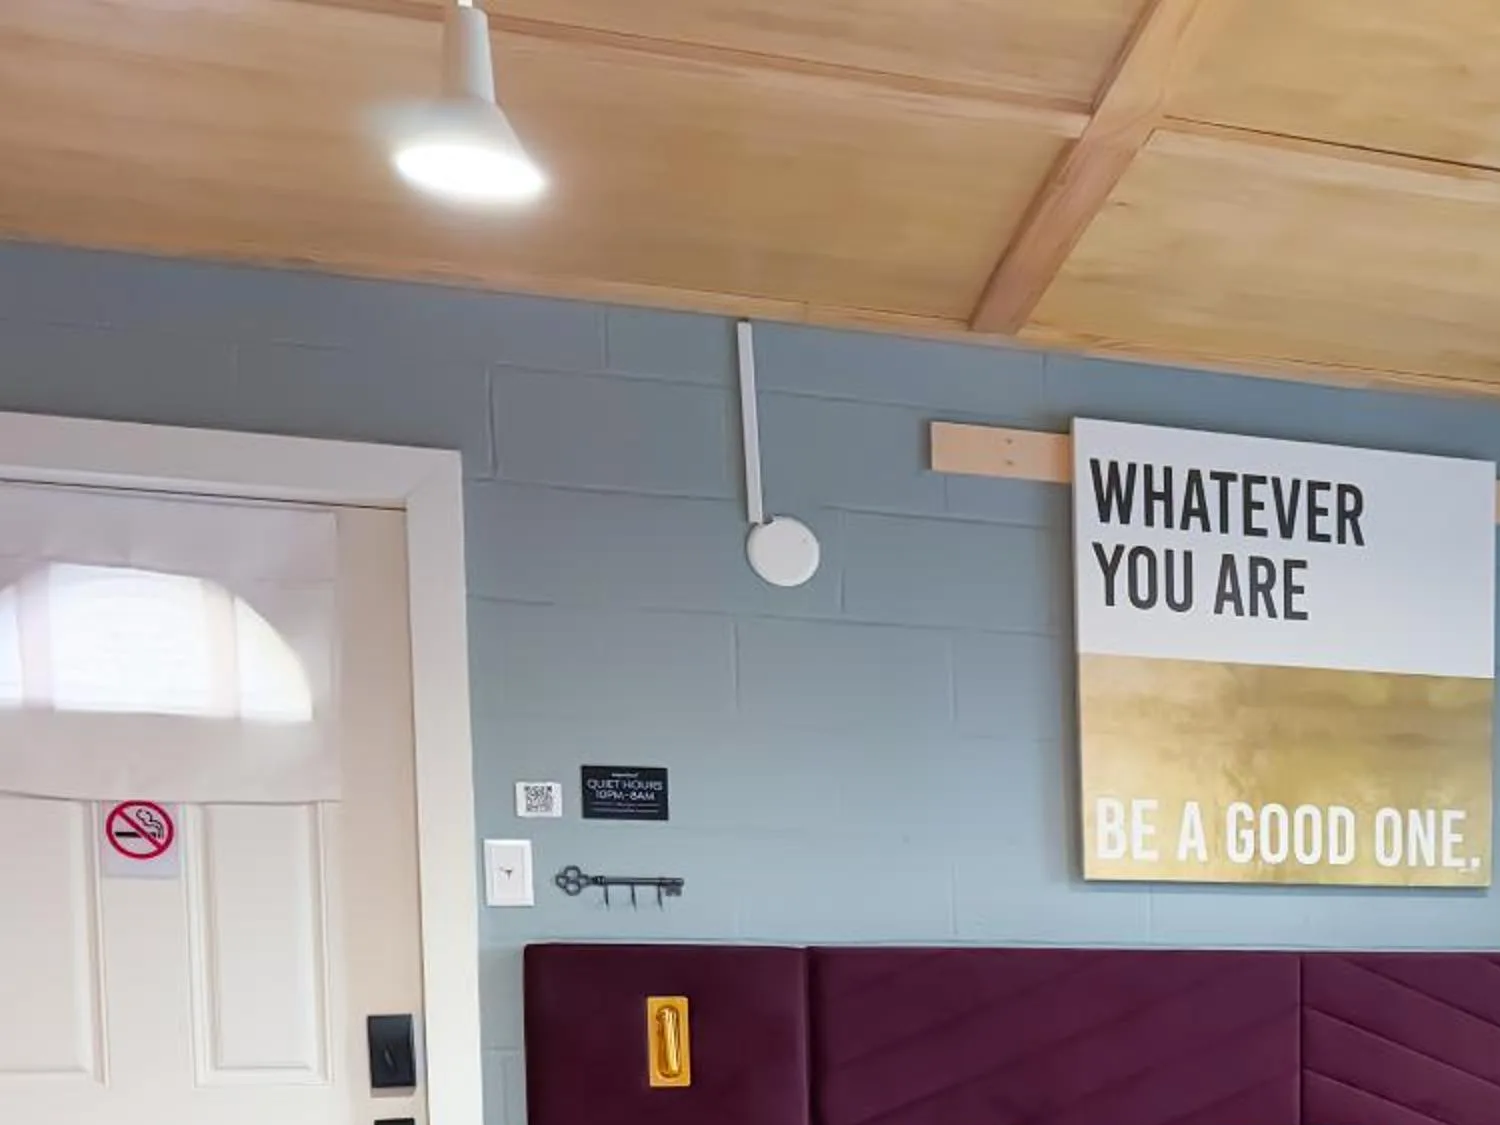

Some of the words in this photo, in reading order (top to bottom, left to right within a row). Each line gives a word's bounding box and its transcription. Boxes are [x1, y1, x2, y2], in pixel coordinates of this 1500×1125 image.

[1090, 458, 1365, 546] WHATEVER
[1092, 542, 1193, 613] YOU
[1213, 553, 1309, 620] ARE
[587, 778, 619, 790] QUIET
[622, 780, 663, 791] HOURS
[1096, 798, 1159, 860] BE
[1177, 800, 1209, 862] A
[1225, 801, 1356, 867] GOOD
[1374, 807, 1481, 868] ONE.
